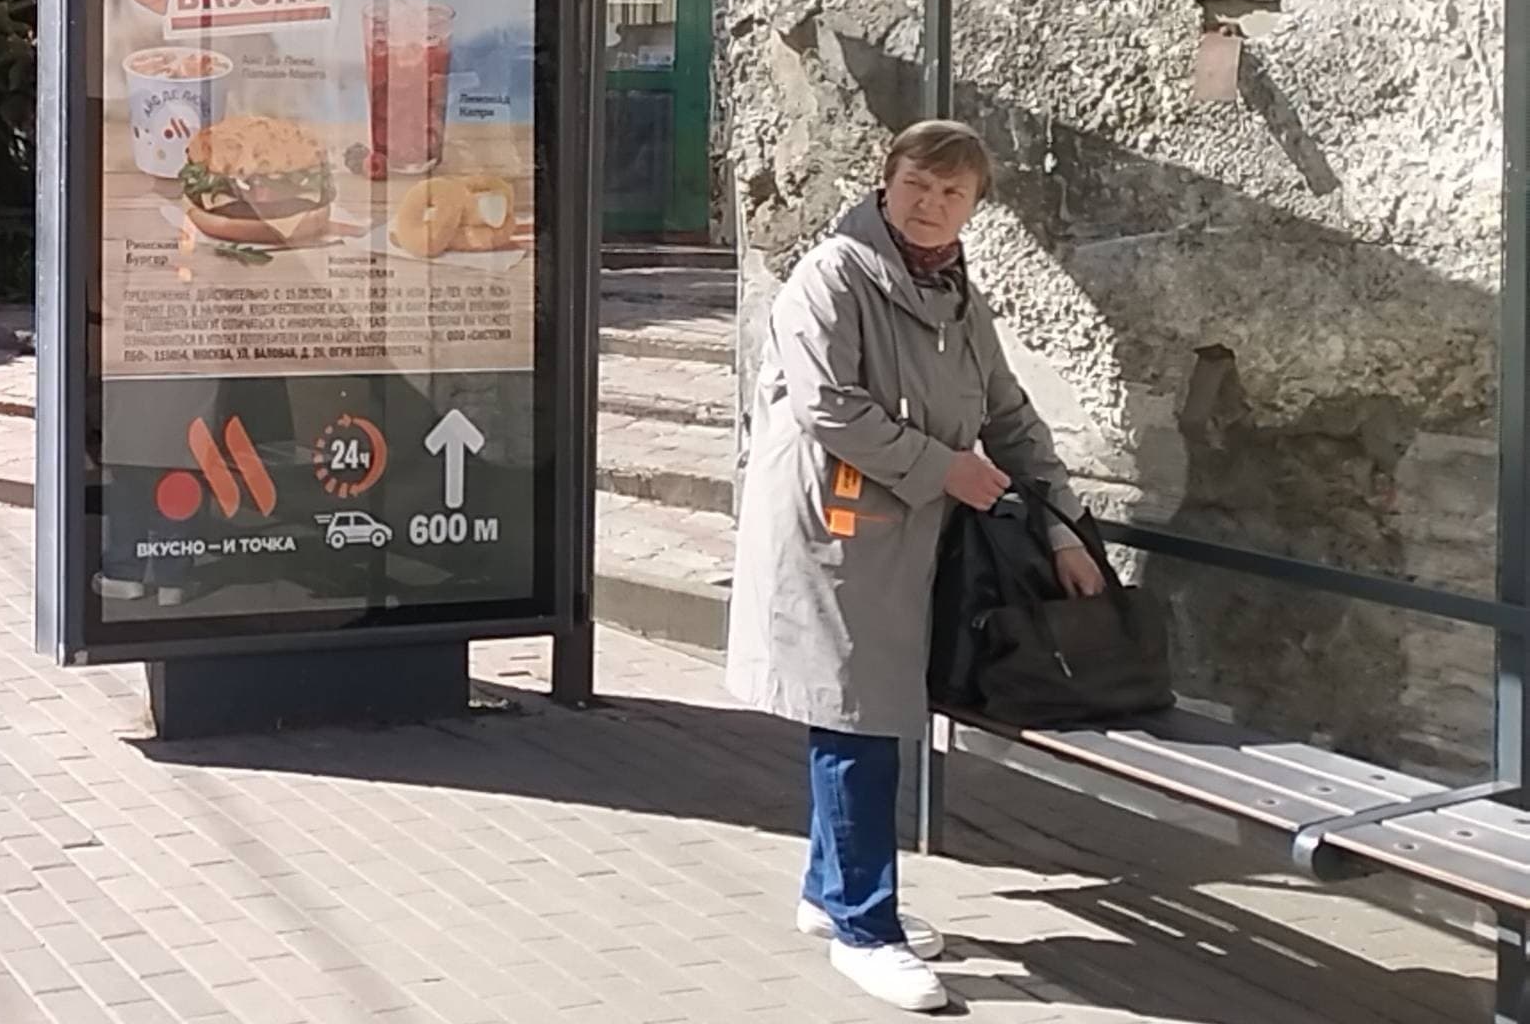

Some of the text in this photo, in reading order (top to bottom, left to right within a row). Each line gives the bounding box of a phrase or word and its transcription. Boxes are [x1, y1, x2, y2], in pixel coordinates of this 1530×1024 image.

[126, 253, 169, 266] Бургер
[409, 514, 468, 545] 600
[136, 540, 205, 558] ВКУСНО
[239, 536, 297, 553] ТОЧКА
